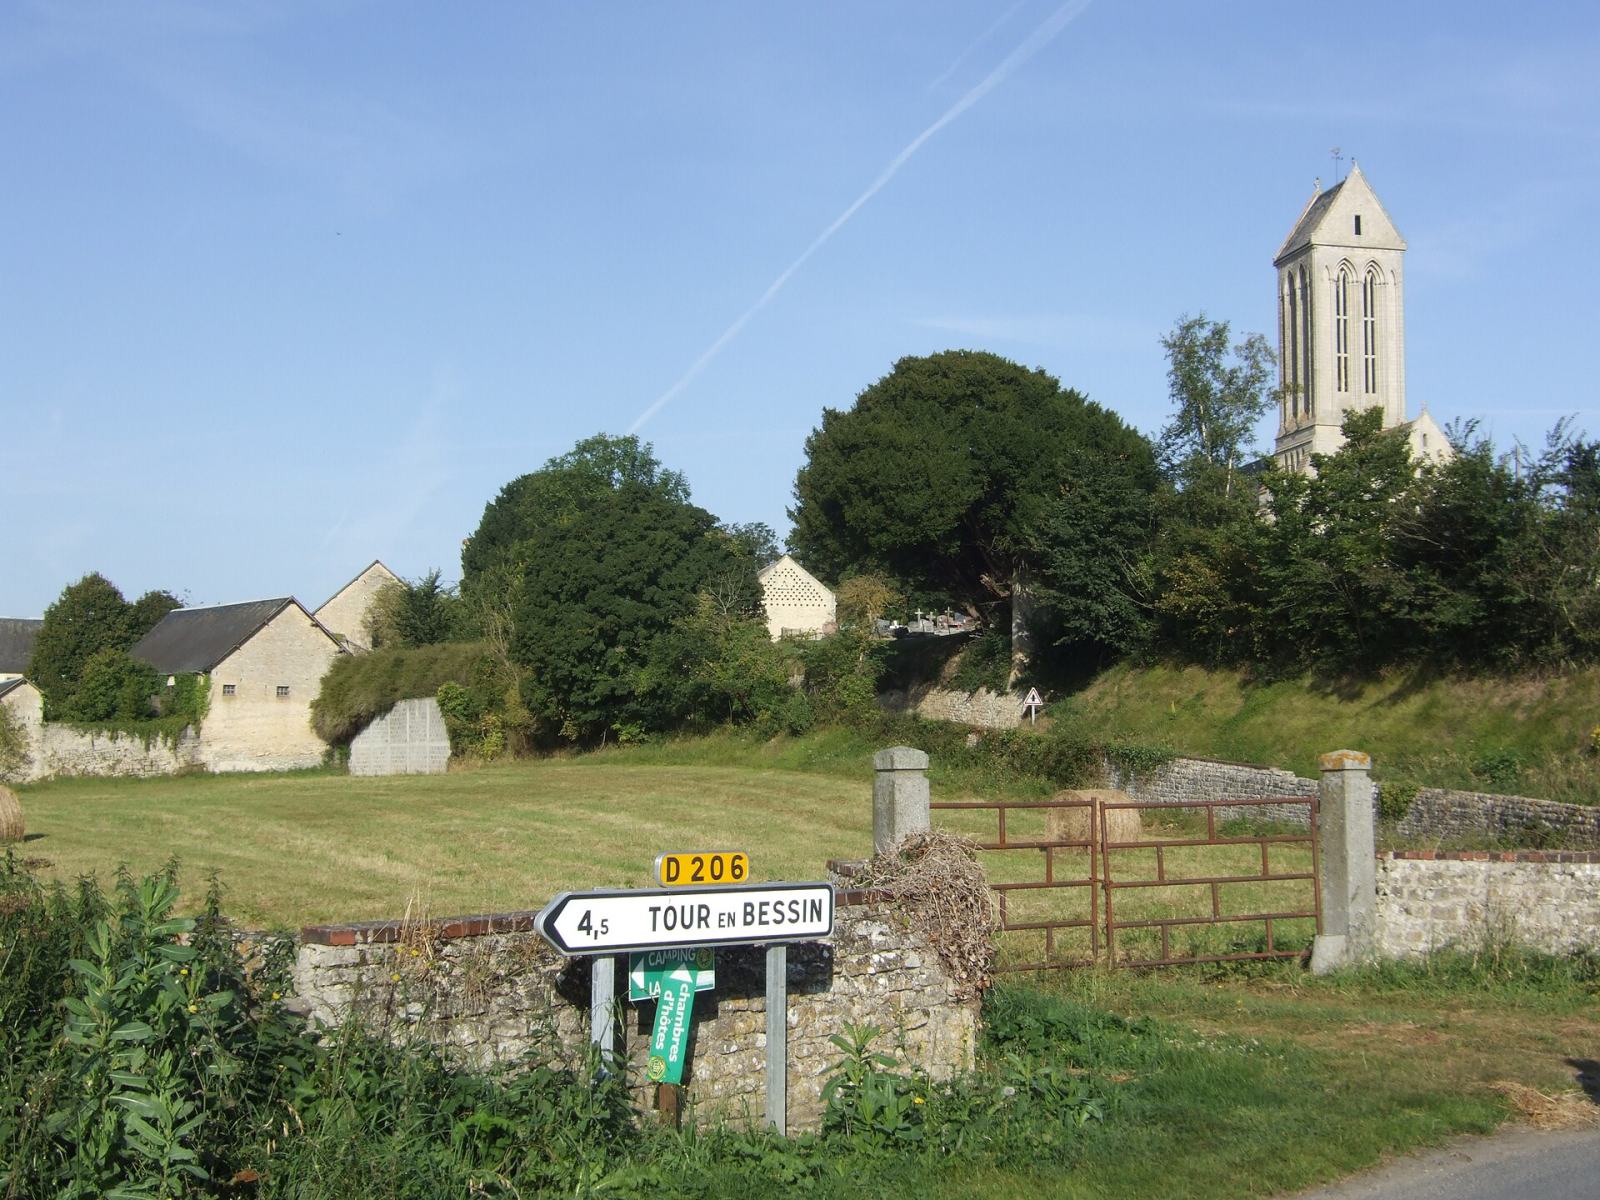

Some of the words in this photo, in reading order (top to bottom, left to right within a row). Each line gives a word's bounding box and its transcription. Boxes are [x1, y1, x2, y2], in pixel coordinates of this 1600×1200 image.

[665, 857, 680, 882] D
[691, 854, 744, 882] 206
[577, 910, 609, 940] 4,5
[648, 904, 711, 932] TOUR
[718, 911, 735, 928] EN
[742, 899, 822, 926] BESSIN
[648, 947, 696, 966] CAMPING
[655, 990, 674, 1050] d'hôtes
[669, 983, 690, 1063] chambres
